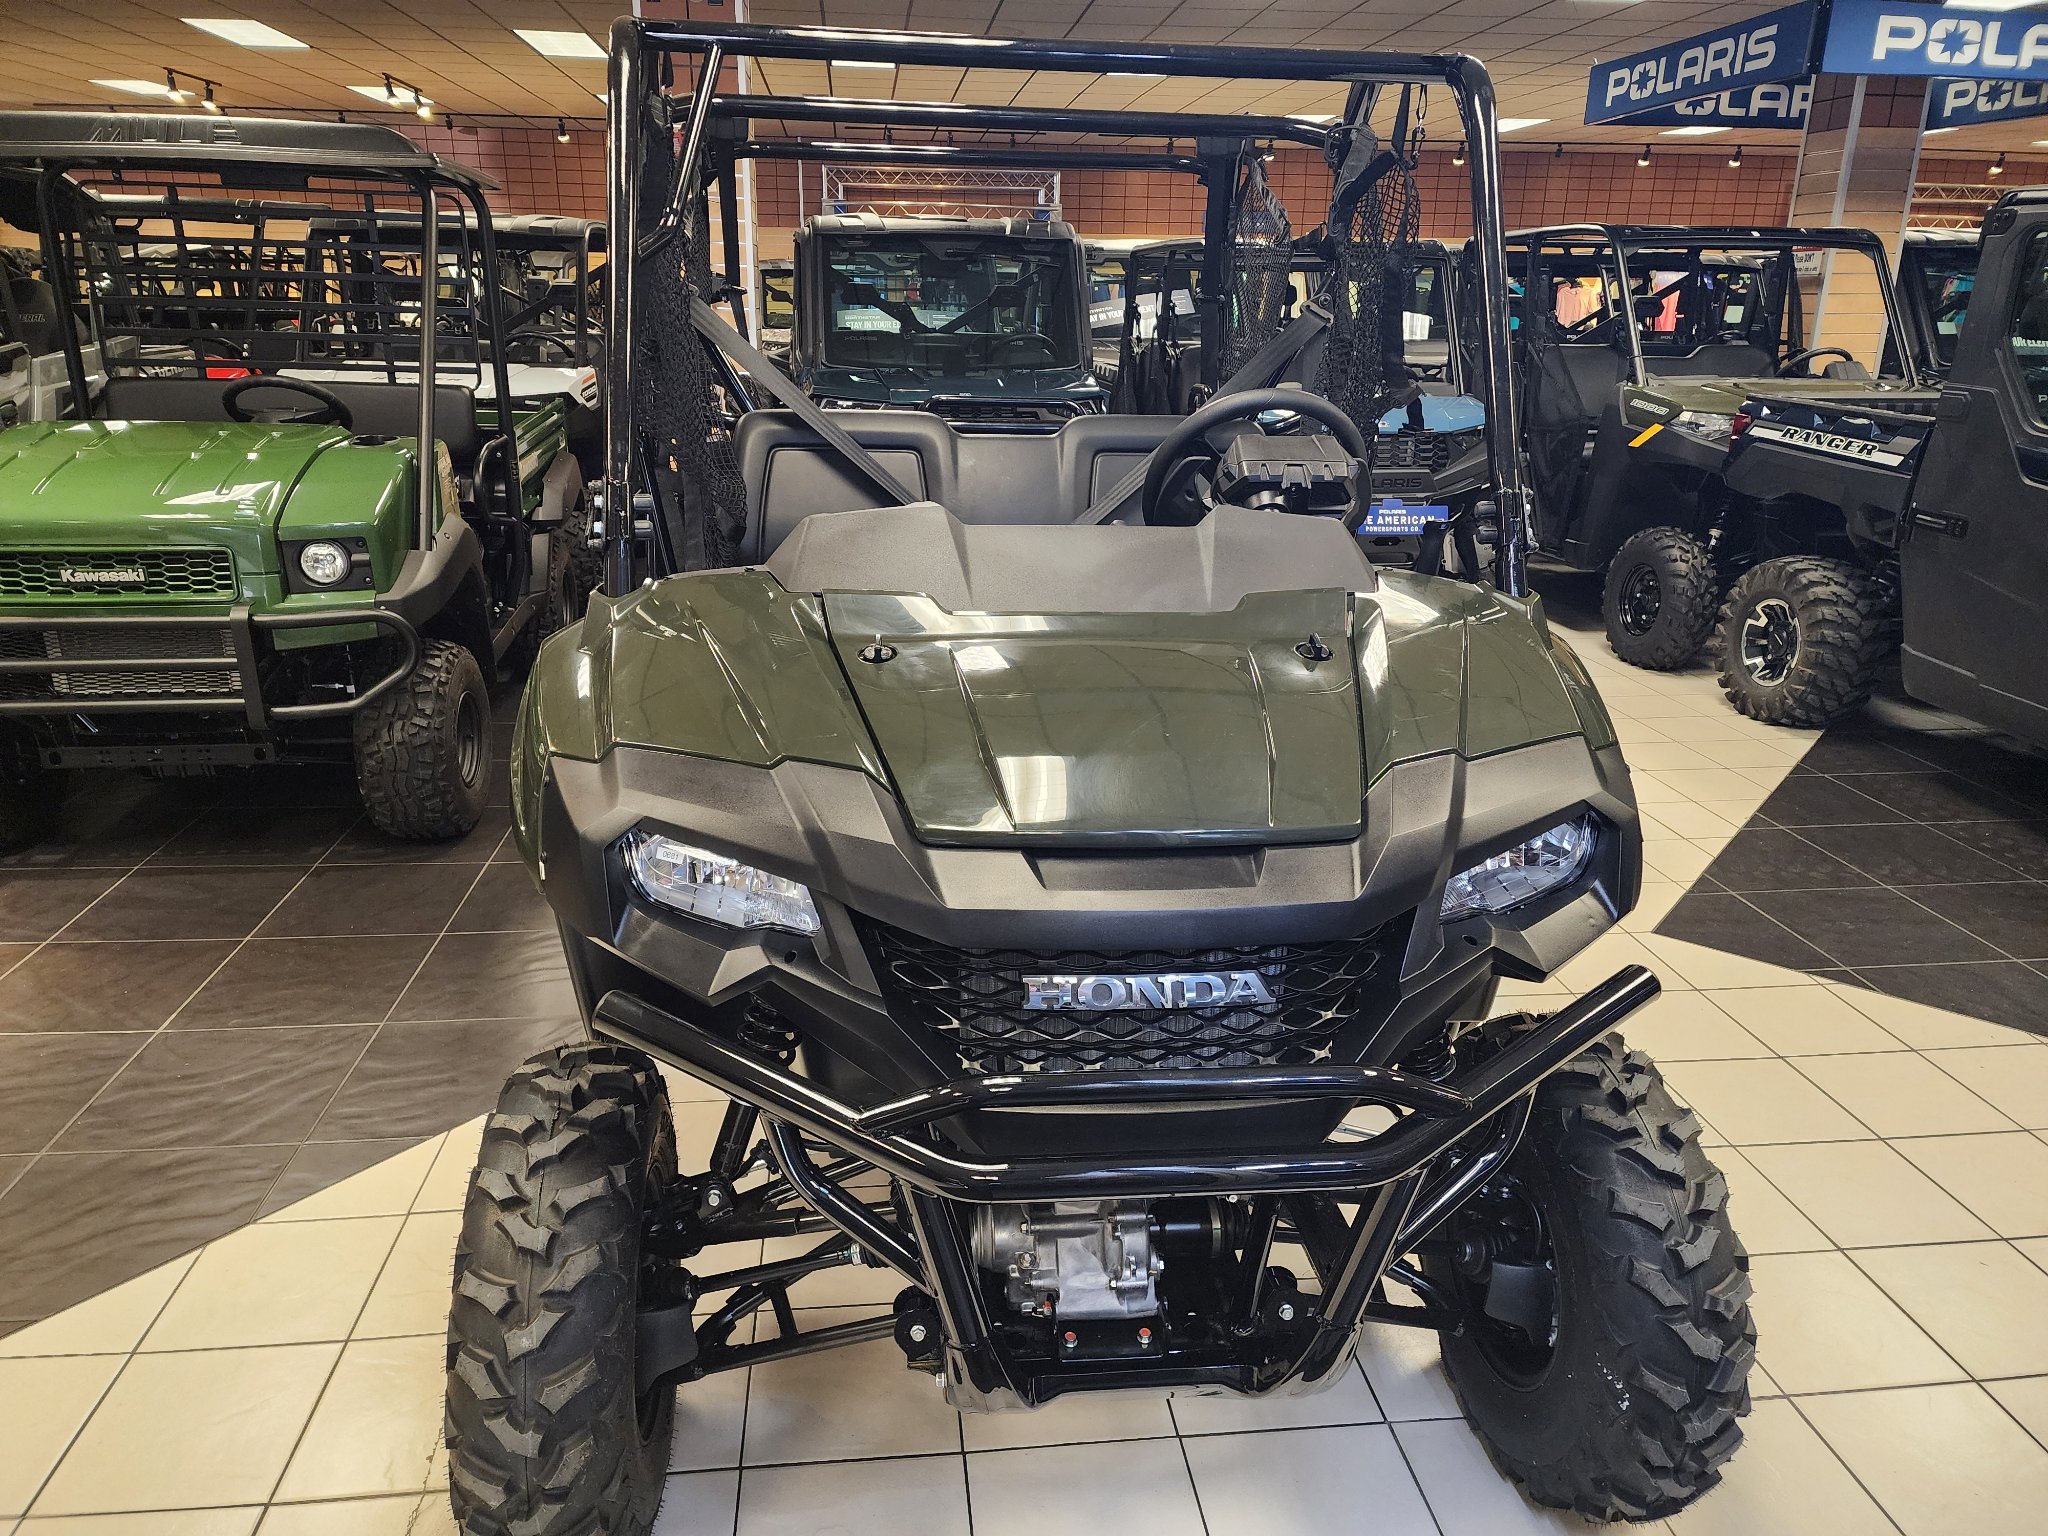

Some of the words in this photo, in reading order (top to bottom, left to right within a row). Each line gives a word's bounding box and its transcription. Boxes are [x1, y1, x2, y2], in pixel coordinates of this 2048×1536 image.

[1606, 24, 1779, 107] POLARIS
[1943, 79, 2048, 118] POL
[845, 320, 863, 329] STAY
[863, 320, 872, 329] IN
[872, 320, 892, 329] YOUR
[1629, 398, 1670, 415] 1000
[1781, 425, 1880, 457] RANGER
[1376, 515, 1435, 525] AMERICAN
[60, 568, 145, 582] Kawasaki
[1022, 972, 1277, 1009] HONDA
